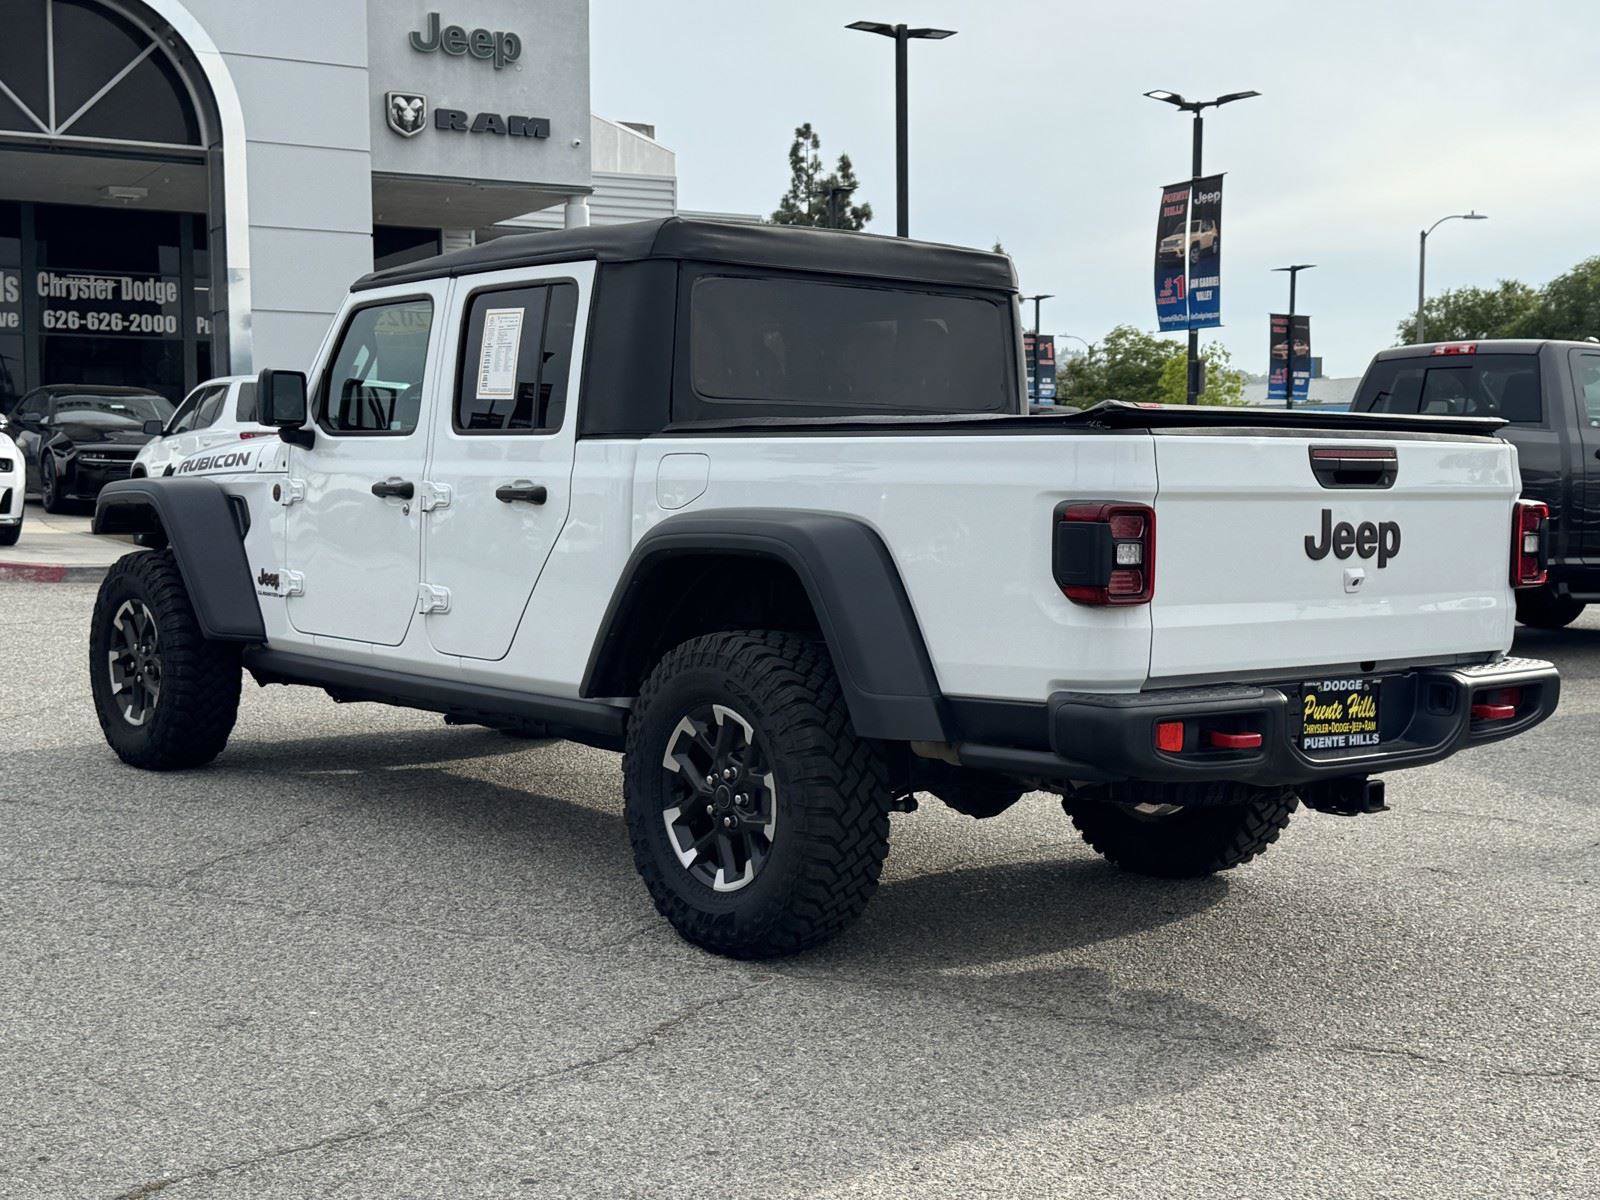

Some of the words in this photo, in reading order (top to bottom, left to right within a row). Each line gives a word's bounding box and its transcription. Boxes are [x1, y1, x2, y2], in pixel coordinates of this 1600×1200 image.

[408, 12, 522, 70] Jeep
[434, 108, 551, 139] RAM
[1194, 191, 1221, 205] Jeep
[37, 271, 119, 300] Chrysler
[121, 276, 177, 305] Dodge
[43, 309, 177, 333] 626-626-2000
[178, 452, 251, 474] RUBICON
[1304, 508, 1402, 569] Jeep
[258, 567, 279, 590] Jeep
[1323, 680, 1363, 691] DODGE
[1303, 694, 1343, 721] Puente
[1346, 692, 1377, 718] Hills
[1303, 736, 1346, 750] PUENTE
[1348, 733, 1380, 746] HILLS
